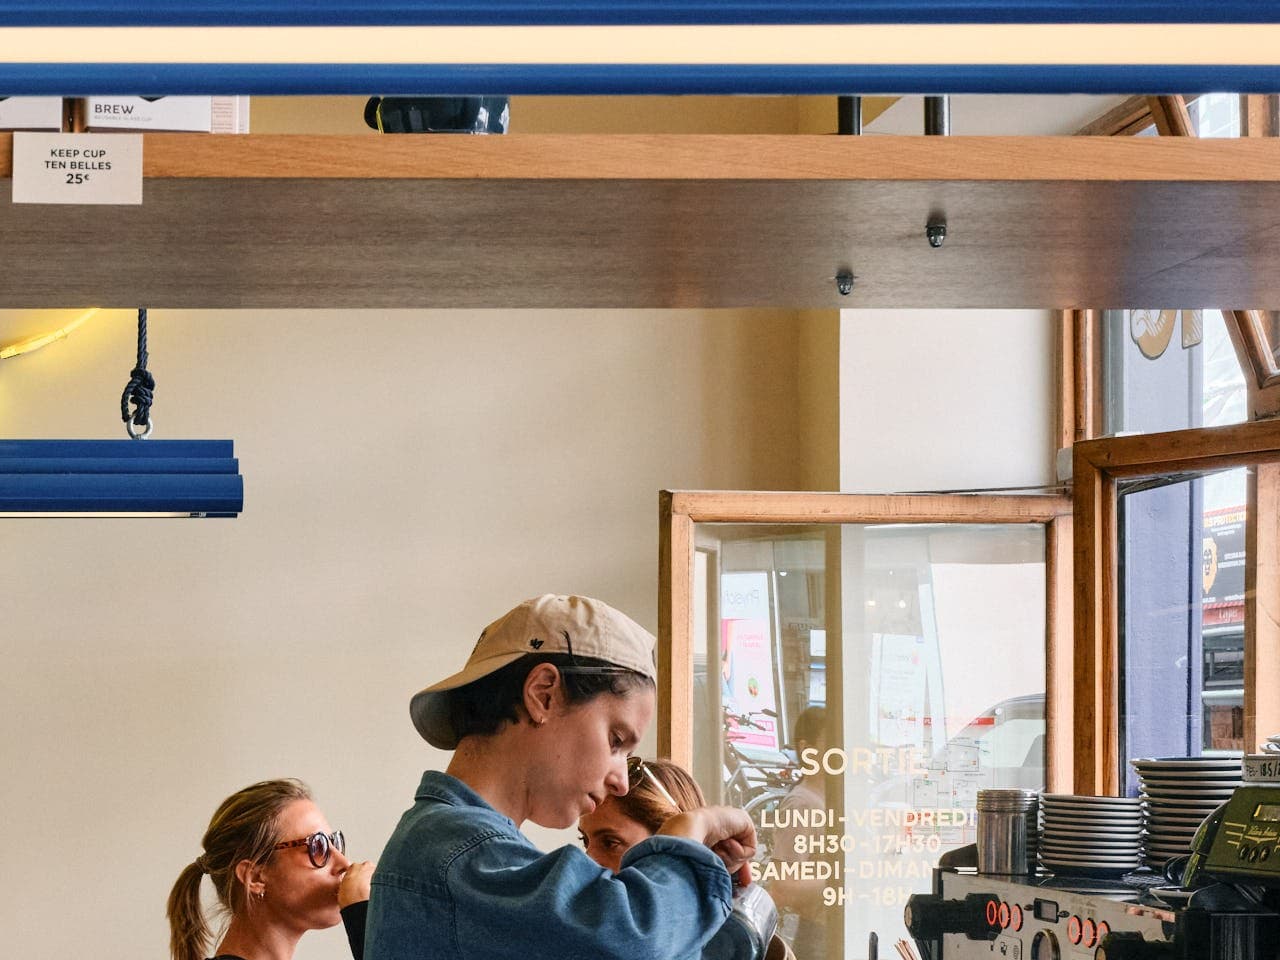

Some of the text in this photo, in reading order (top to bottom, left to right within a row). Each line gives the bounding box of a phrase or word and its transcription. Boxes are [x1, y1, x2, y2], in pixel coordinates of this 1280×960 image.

[94, 104, 134, 114] BREW
[50, 149, 107, 159] KEEP CUP
[45, 160, 112, 171] TEN BELLES
[66, 173, 91, 184] 25€
[800, 747, 930, 776] SORTIE
